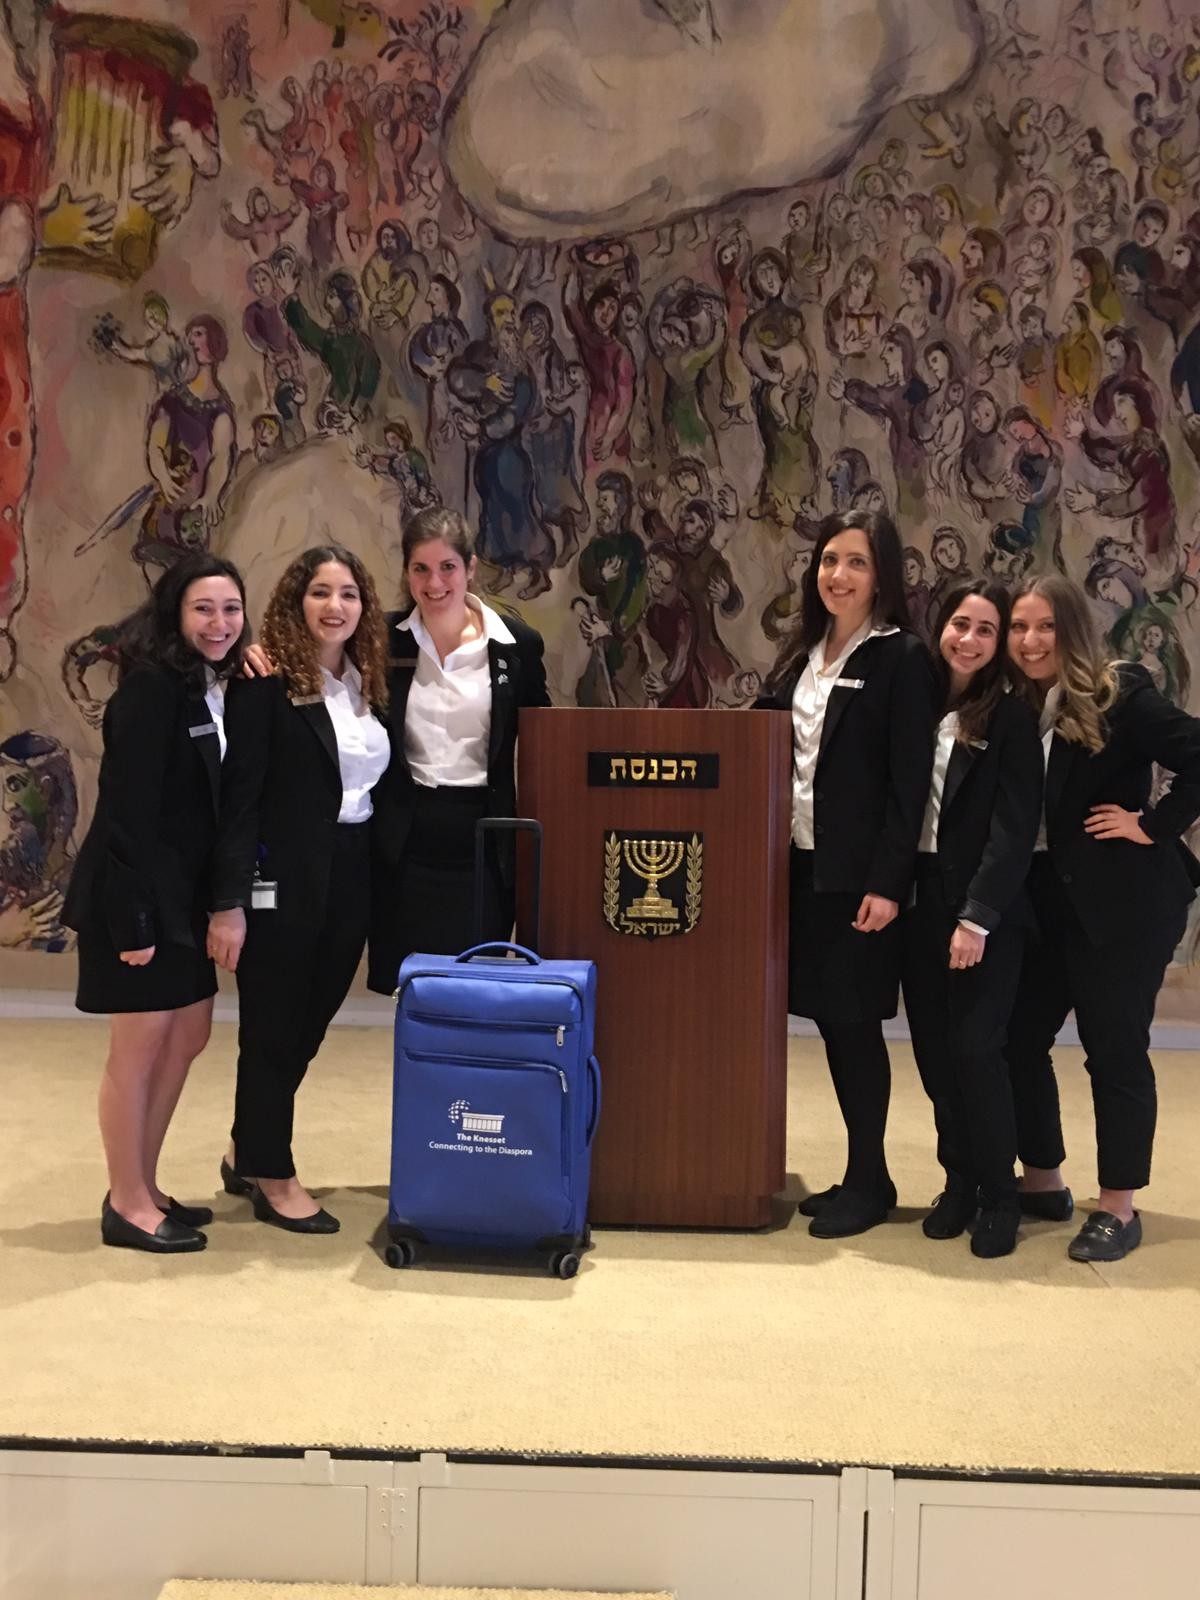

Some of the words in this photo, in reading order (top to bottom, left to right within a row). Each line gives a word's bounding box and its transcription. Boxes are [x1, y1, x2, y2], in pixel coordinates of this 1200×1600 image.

[610, 758, 698, 781] הכנסת
[620, 912, 681, 936] ישראל
[457, 1133, 472, 1142] The
[473, 1135, 506, 1144] Knesset
[428, 1141, 474, 1154] Connecting
[475, 1145, 484, 1153] to
[484, 1146, 498, 1154] the
[498, 1147, 533, 1156] Diaspora
